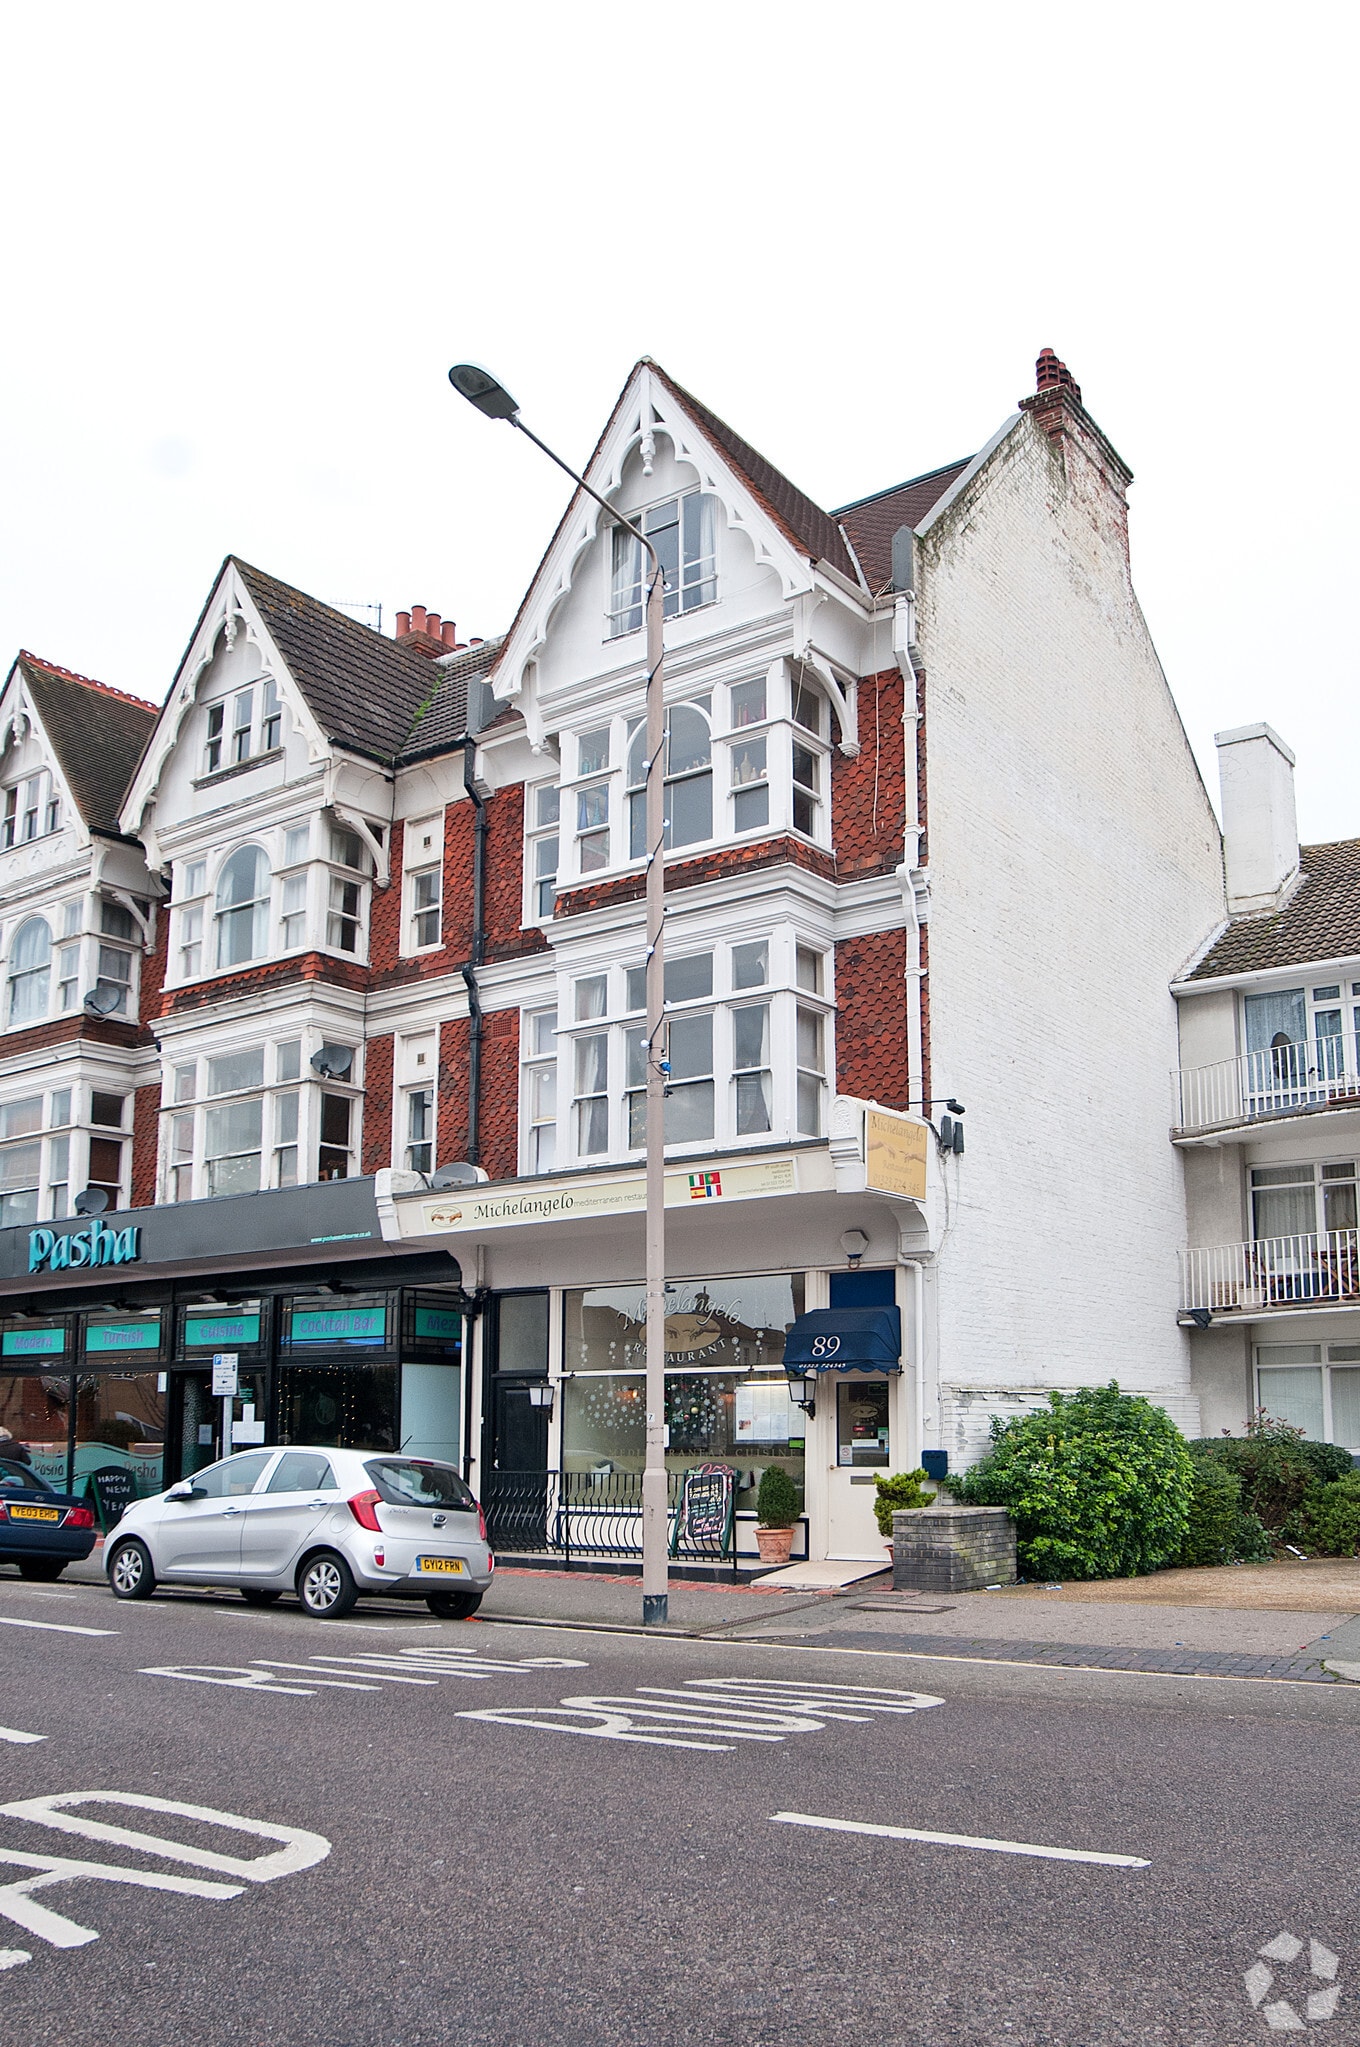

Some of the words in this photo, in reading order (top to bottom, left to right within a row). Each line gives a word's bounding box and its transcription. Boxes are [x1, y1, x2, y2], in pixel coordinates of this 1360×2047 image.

[473, 1192, 574, 1220] Michelangelo
[574, 1196, 622, 1207] mediterranean
[624, 1193, 647, 1202] restau
[29, 1220, 138, 1272] Pasha
[200, 1322, 244, 1338] Cuisine
[300, 1315, 349, 1333] Cocktail
[353, 1315, 376, 1331] Bar
[14, 1335, 52, 1349] Modern
[103, 1328, 144, 1344] Turkish
[811, 1336, 841, 1358] 89
[610, 1448, 726, 1457] MEDIRANEAN
[735, 1448, 796, 1457] CUISINE
[97, 1475, 126, 1483] HAPPY
[106, 1485, 131, 1494] NEW
[16, 1507, 37, 1517] YE03
[424, 1559, 443, 1571] GY12
[444, 1561, 460, 1572] FRN
[454, 1678, 946, 1752] ROAD
